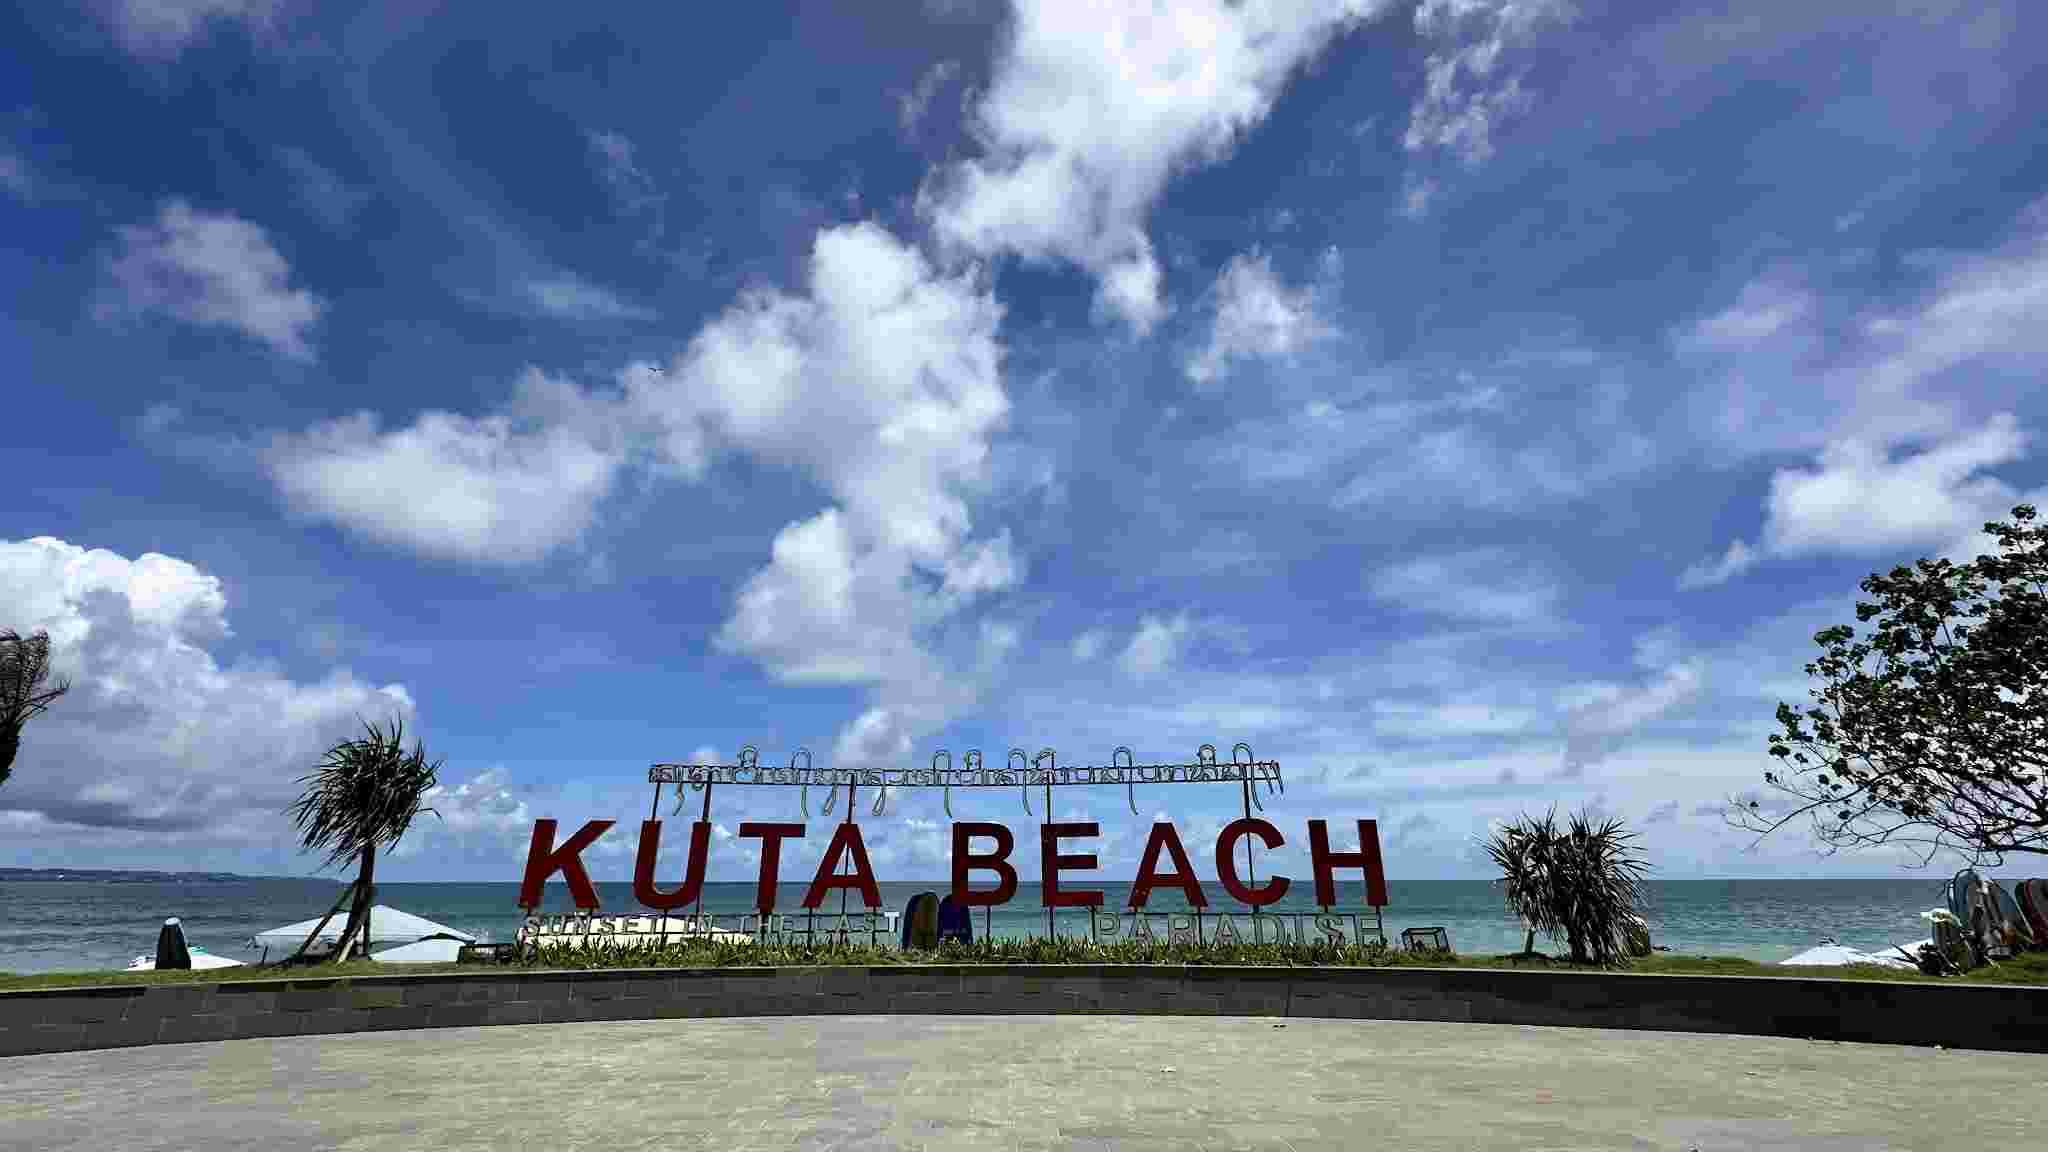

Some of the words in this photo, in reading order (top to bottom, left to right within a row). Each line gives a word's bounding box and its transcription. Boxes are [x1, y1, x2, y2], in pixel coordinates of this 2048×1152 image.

[518, 818, 882, 913] KUTA
[951, 817, 1389, 907] BEACH
[526, 912, 662, 937] SUNSET
[1092, 911, 1384, 945] PARADISE
